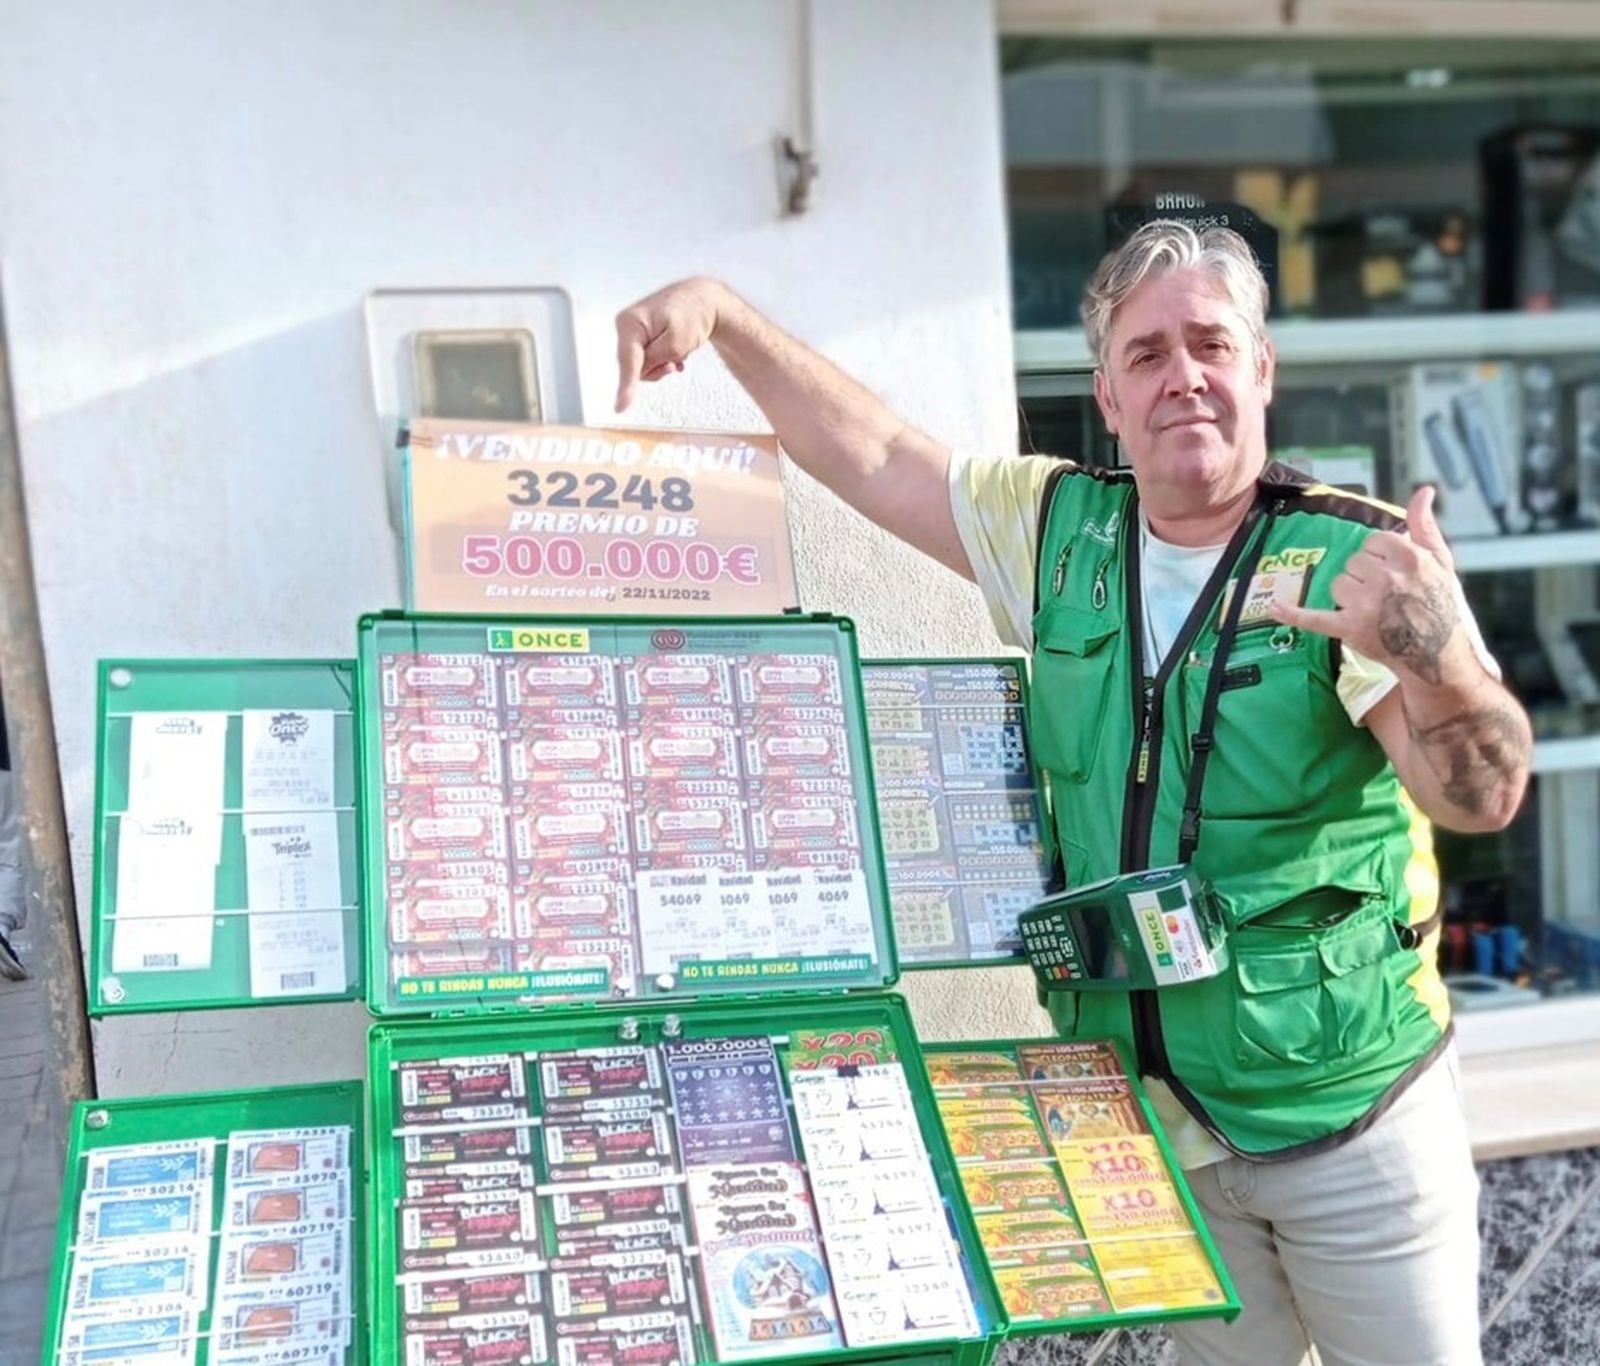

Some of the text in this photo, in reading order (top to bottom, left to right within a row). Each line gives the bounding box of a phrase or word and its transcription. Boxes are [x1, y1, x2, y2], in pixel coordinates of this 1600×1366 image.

[1220, 215, 1229, 226] 3
[506, 469, 695, 512] 32248
[508, 511, 699, 538] PREMIO DE
[462, 535, 761, 585] 500.000€
[486, 585, 508, 597] En
[511, 585, 528, 597] el
[530, 587, 586, 598] sorteo
[622, 587, 711, 601] 22/11/2022
[518, 632, 583, 648] ONCE
[660, 893, 701, 907] 54069
[1145, 911, 1165, 951] ONCE
[683, 966, 697, 977] NO
[702, 965, 714, 976] TE
[718, 963, 758, 976] RINDAS
[762, 962, 799, 974] NUNCA
[401, 981, 418, 994] NO
[422, 980, 435, 993] TE
[667, 1039, 770, 1054] 1.000.000€
[286, 1282, 332, 1298] 60719
